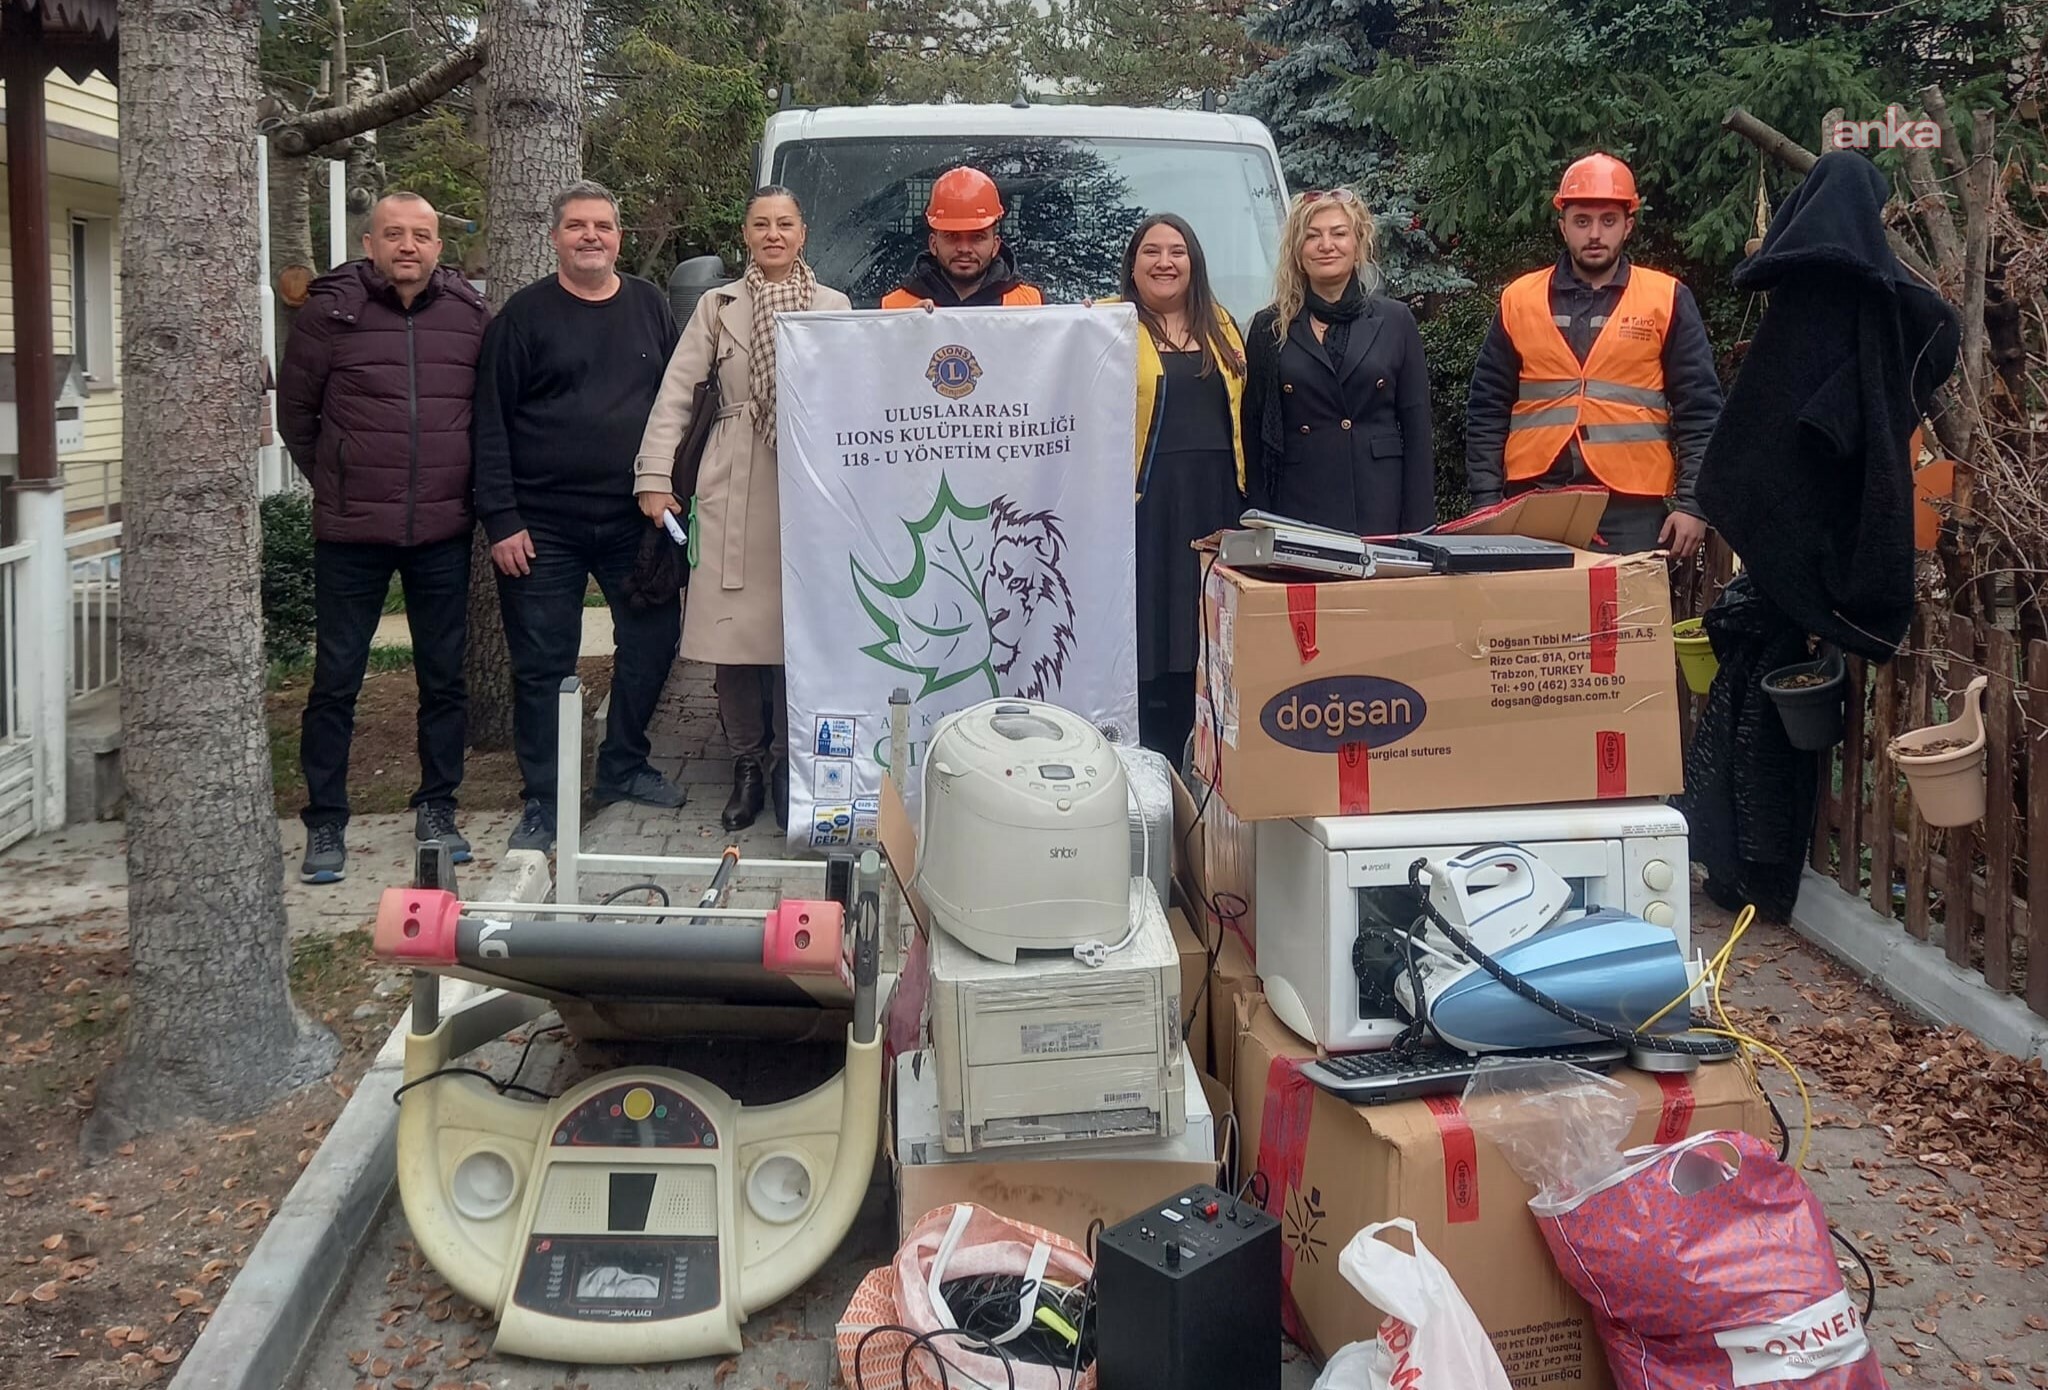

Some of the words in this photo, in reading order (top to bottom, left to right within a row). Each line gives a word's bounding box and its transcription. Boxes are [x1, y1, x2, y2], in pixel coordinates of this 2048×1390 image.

[936, 348, 969, 359] LIONS
[946, 362, 963, 380] L
[884, 402, 1029, 422] ULUSLARARASI
[836, 430, 894, 446] LIONS
[900, 421, 1004, 442] KULÜPLERİ
[1008, 414, 1076, 438] BİRLİĞİ
[842, 452, 870, 466] 118
[885, 450, 898, 464] U
[904, 442, 991, 462] YÖNETİM
[996, 436, 1070, 462] ÇEVRESİ
[1490, 638, 1530, 650] Doğsan
[1533, 634, 1559, 646] Tıbbi
[1636, 628, 1656, 638] A.Ş.
[1490, 656, 1512, 666] Rize
[1515, 654, 1540, 665] Cad.
[1542, 652, 1566, 664] 91A,
[1568, 650, 1592, 661] Orta
[1490, 668, 1538, 680] Trabzon,
[1540, 664, 1584, 677] TURKEY
[1491, 683, 1510, 694] Tel:
[1512, 681, 1535, 692] +90
[1538, 679, 1568, 692] (462)
[1570, 677, 1592, 688] 334
[1594, 676, 1609, 687] 06
[1612, 674, 1626, 686] 90
[1490, 690, 1621, 709] dogsan@dogsan.com.tr
[1276, 693, 1412, 737] doğsan
[1366, 748, 1408, 761] surgical
[1410, 746, 1452, 758] sutures
[1488, 1318, 1583, 1340] dogsan@dogsan.com
[1510, 1340, 1524, 1349] 334
[1506, 1348, 1544, 1362] TURKEY
[1563, 1352, 1582, 1362] Rize
[1541, 1368, 1582, 1383] Doğsan
